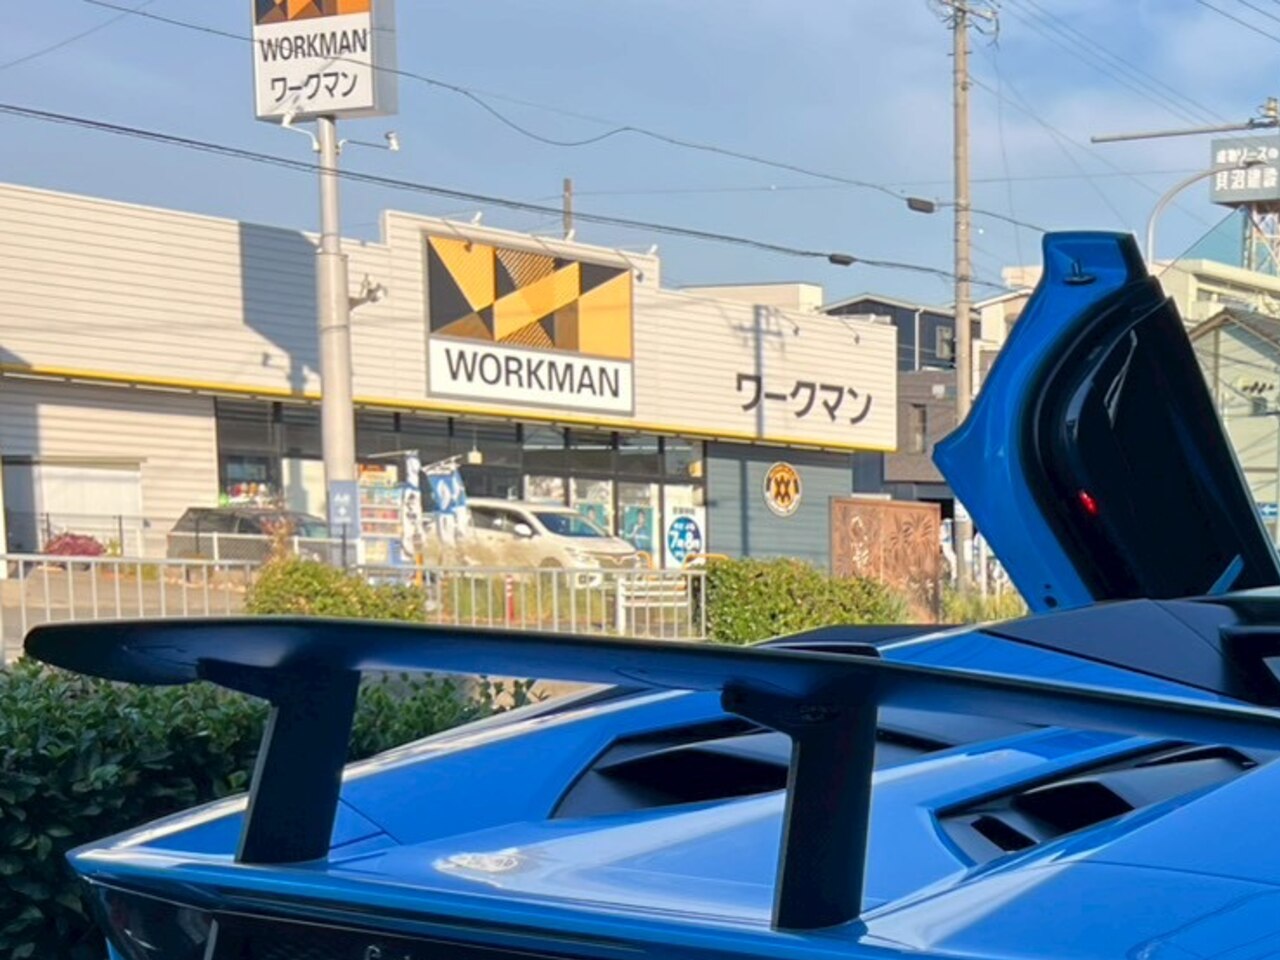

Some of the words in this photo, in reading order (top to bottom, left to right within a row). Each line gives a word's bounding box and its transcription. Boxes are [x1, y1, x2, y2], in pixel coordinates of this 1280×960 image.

[259, 28, 367, 62] WORKMAN
[271, 72, 358, 103] ワークマン
[445, 347, 620, 398] WORKMAN
[736, 372, 873, 425] ワークマン
